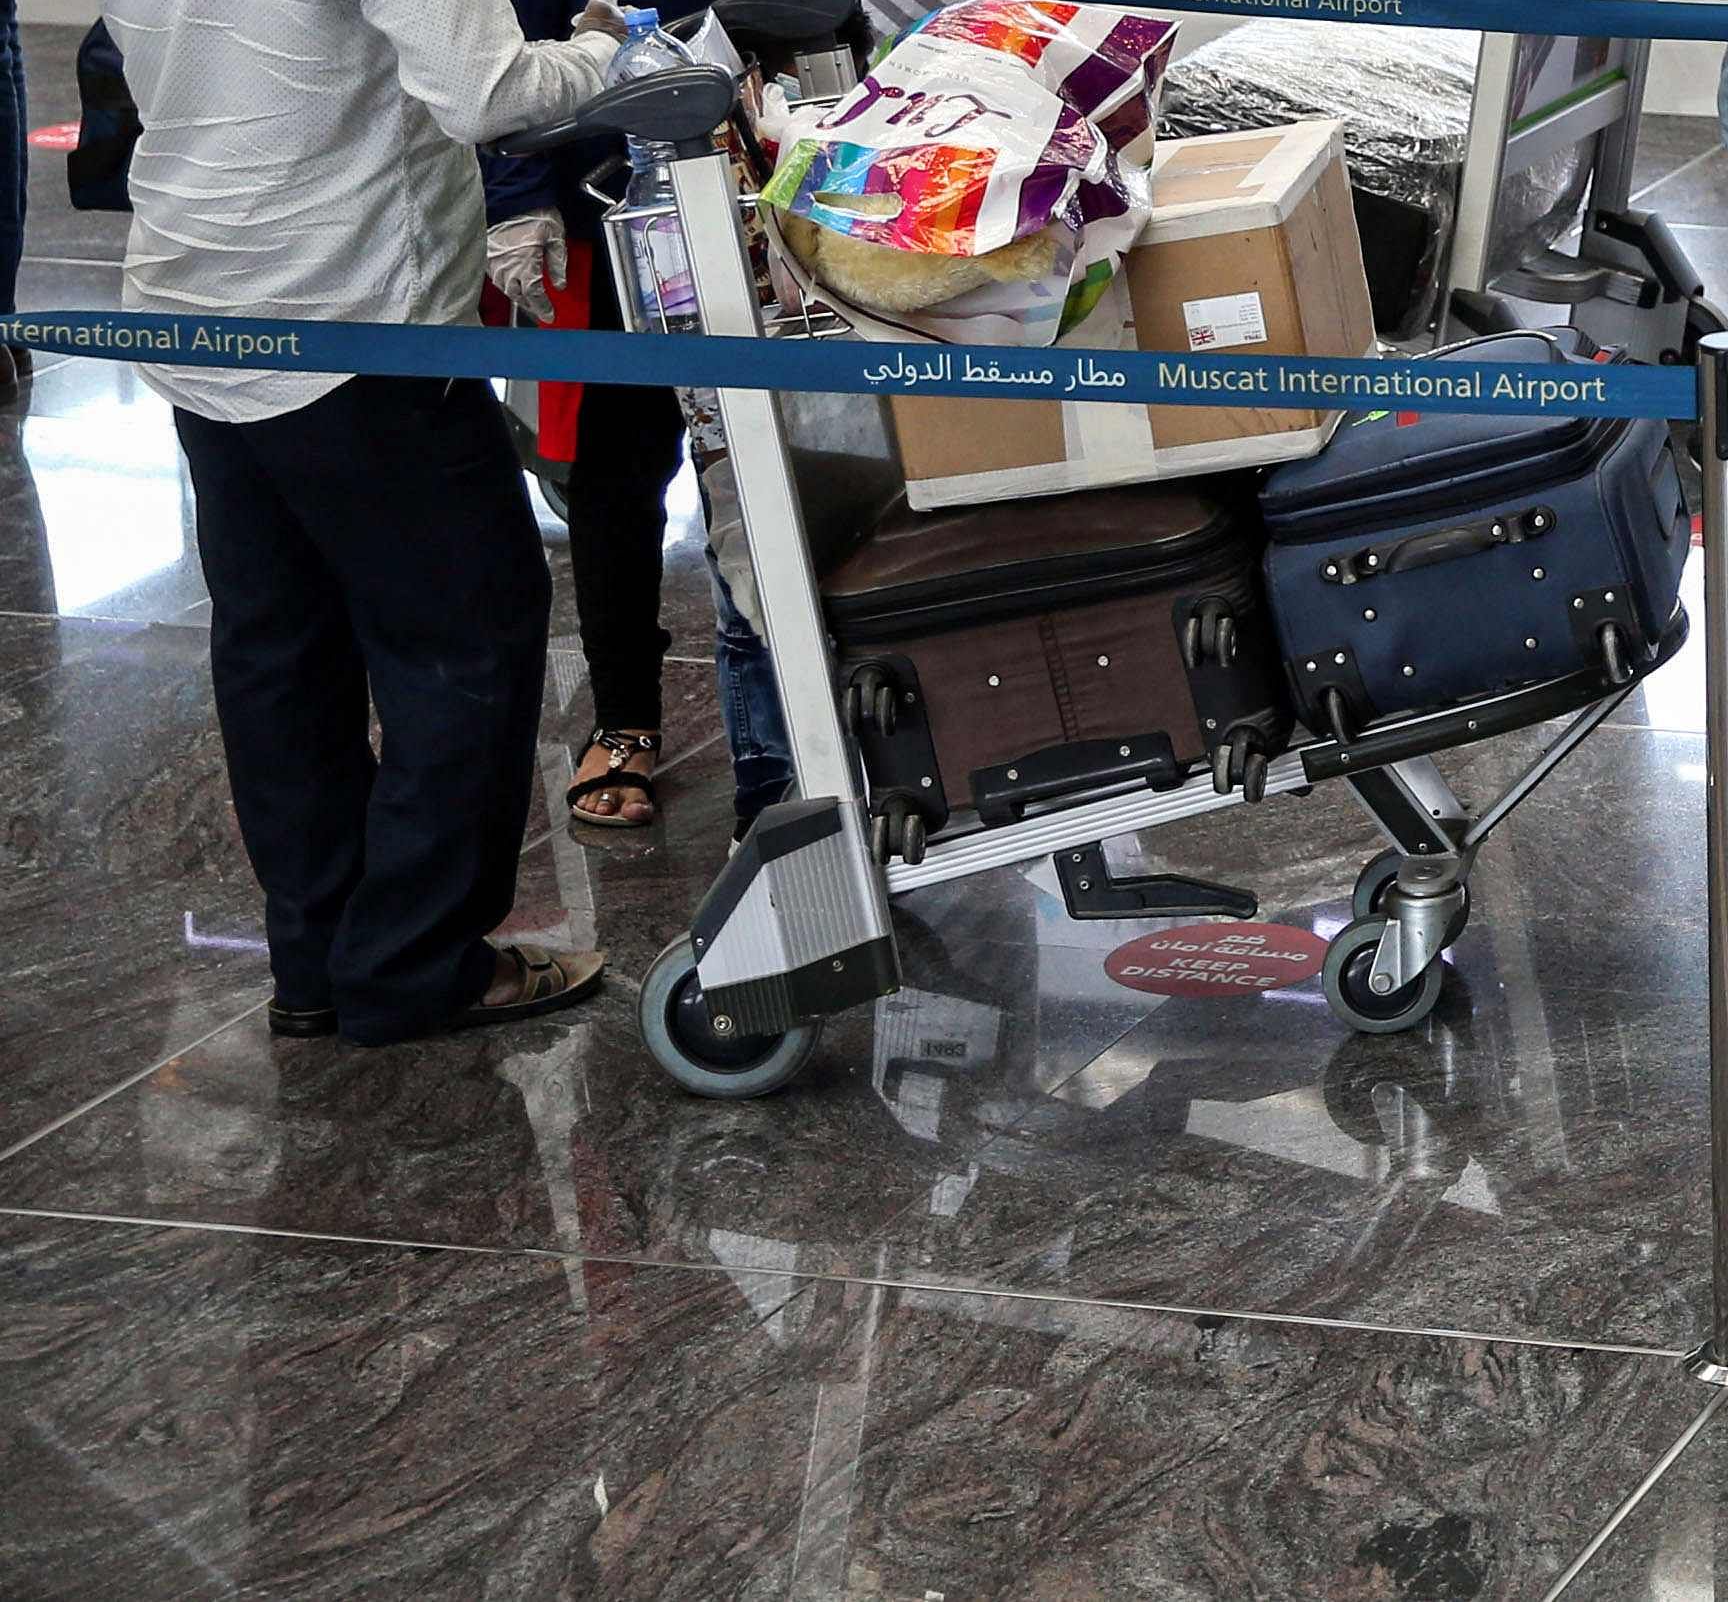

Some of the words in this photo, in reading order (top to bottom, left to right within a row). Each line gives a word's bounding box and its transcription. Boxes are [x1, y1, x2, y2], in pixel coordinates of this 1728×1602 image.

[0, 320, 179, 349] nternational
[192, 326, 300, 359] Airport
[864, 352, 951, 385] الدولي
[962, 355, 1053, 384] مسقط
[1065, 359, 1125, 391] مطار
[1159, 363, 1268, 391] Muscat
[1280, 367, 1480, 398] International
[1493, 373, 1605, 406] Airport
[1169, 958, 1249, 971] KEEP
[1214, 945, 1309, 962] مسافة
[1119, 966, 1276, 987] DISTANCE
